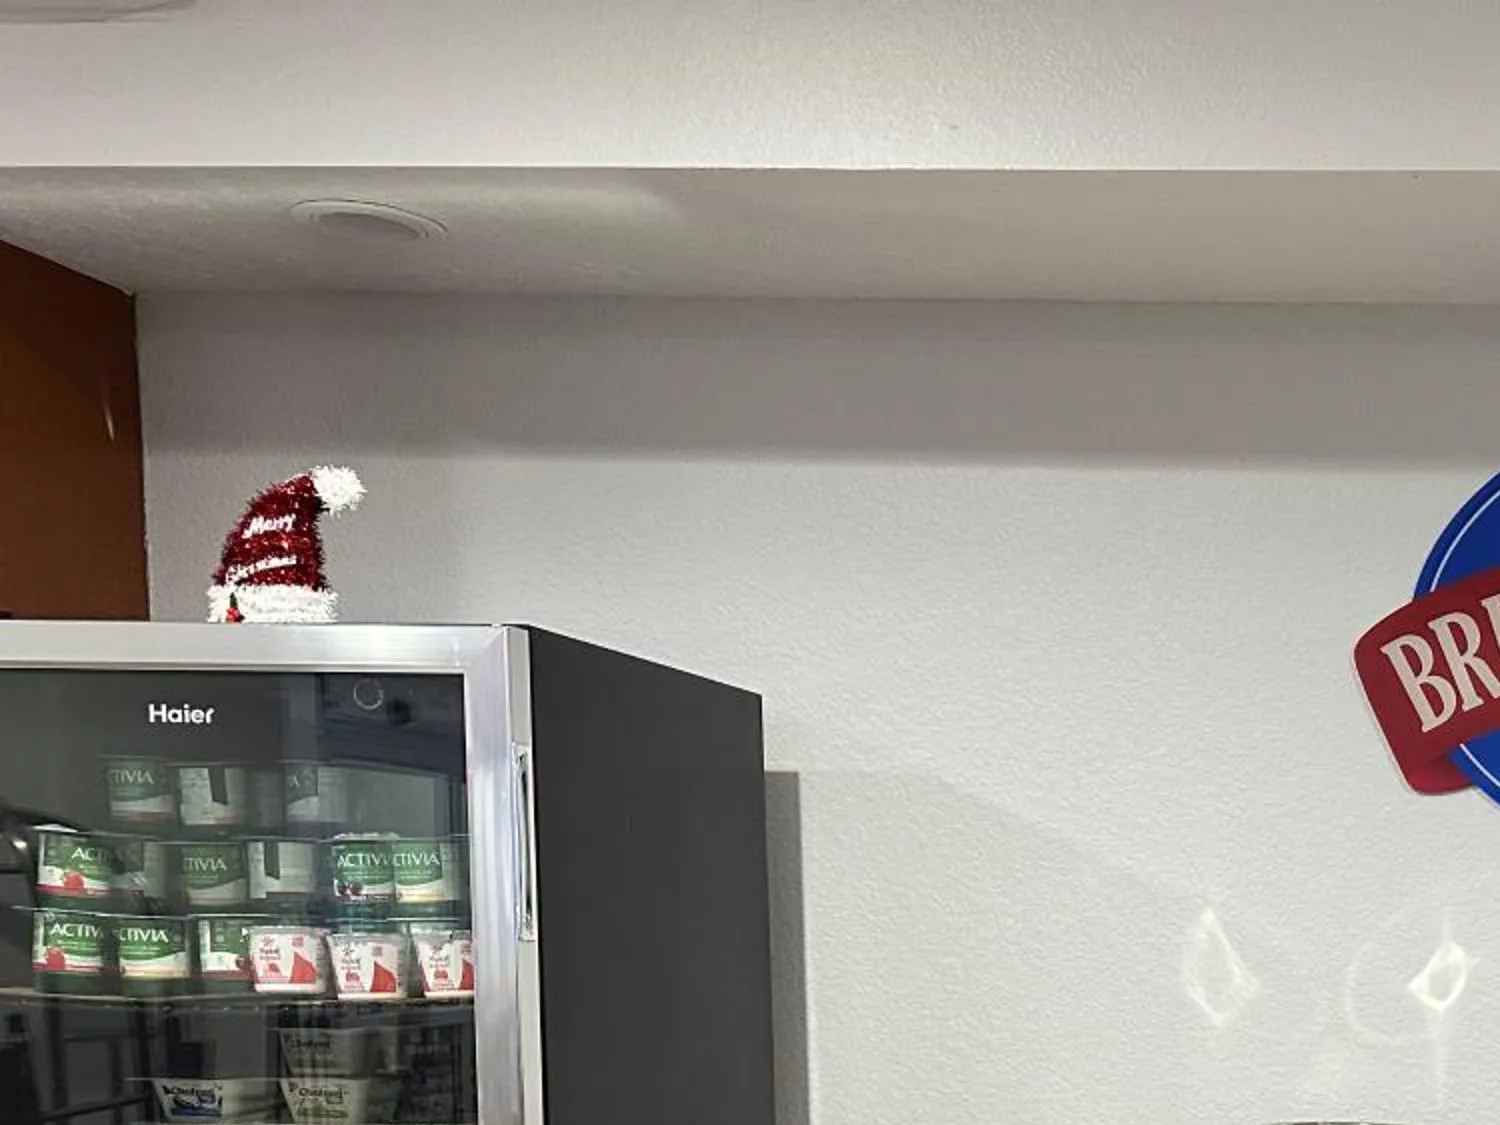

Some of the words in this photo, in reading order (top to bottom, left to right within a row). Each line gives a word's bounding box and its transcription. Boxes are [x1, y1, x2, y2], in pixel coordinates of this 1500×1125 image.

[241, 512, 297, 539] Merry
[148, 703, 215, 724] Haier
[115, 927, 169, 943] CTIVIA
